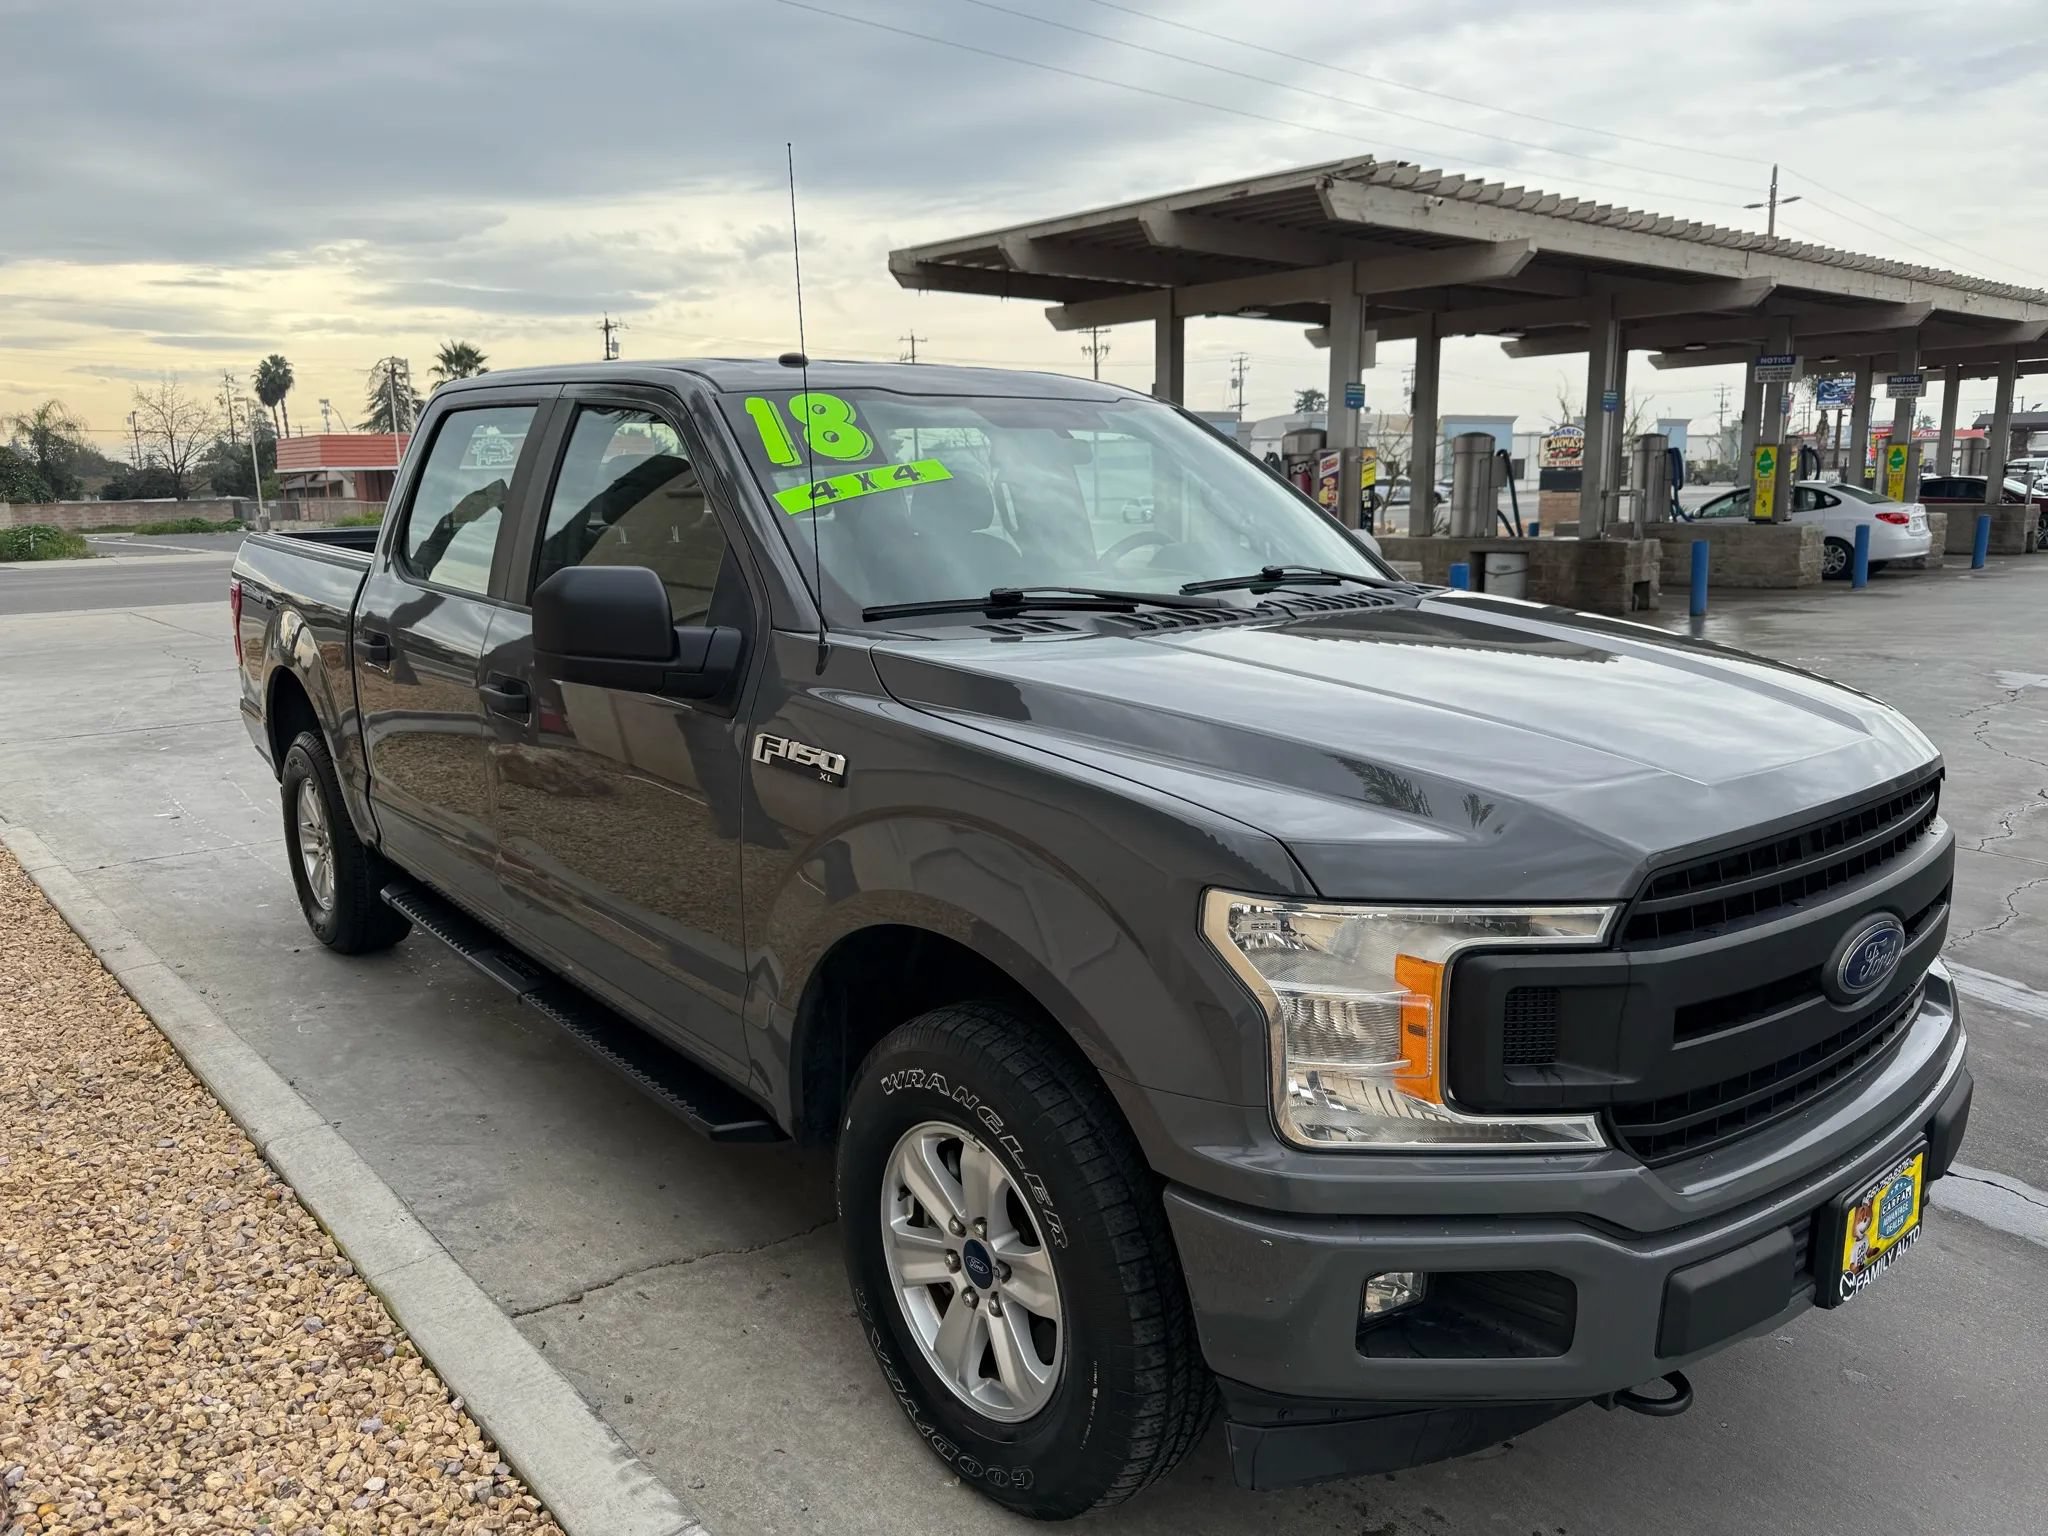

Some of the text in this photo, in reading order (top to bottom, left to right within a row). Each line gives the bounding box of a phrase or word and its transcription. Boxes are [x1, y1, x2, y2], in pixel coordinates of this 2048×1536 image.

[1760, 356, 1792, 364] NOTICE
[745, 393, 873, 467] 18
[808, 480, 843, 500] 4
[892, 464, 926, 482] 4
[820, 772, 833, 783] XL
[1859, 937, 1896, 982] Ford
[880, 1068, 1068, 1249] WRANGLER
[1881, 1184, 1912, 1216] CARFAX
[1882, 1201, 1909, 1228] ADVANTAGE
[1886, 1215, 1904, 1235] DEALER
[1855, 1248, 1894, 1294] FAMILY
[1895, 1225, 1920, 1261] AUTO
